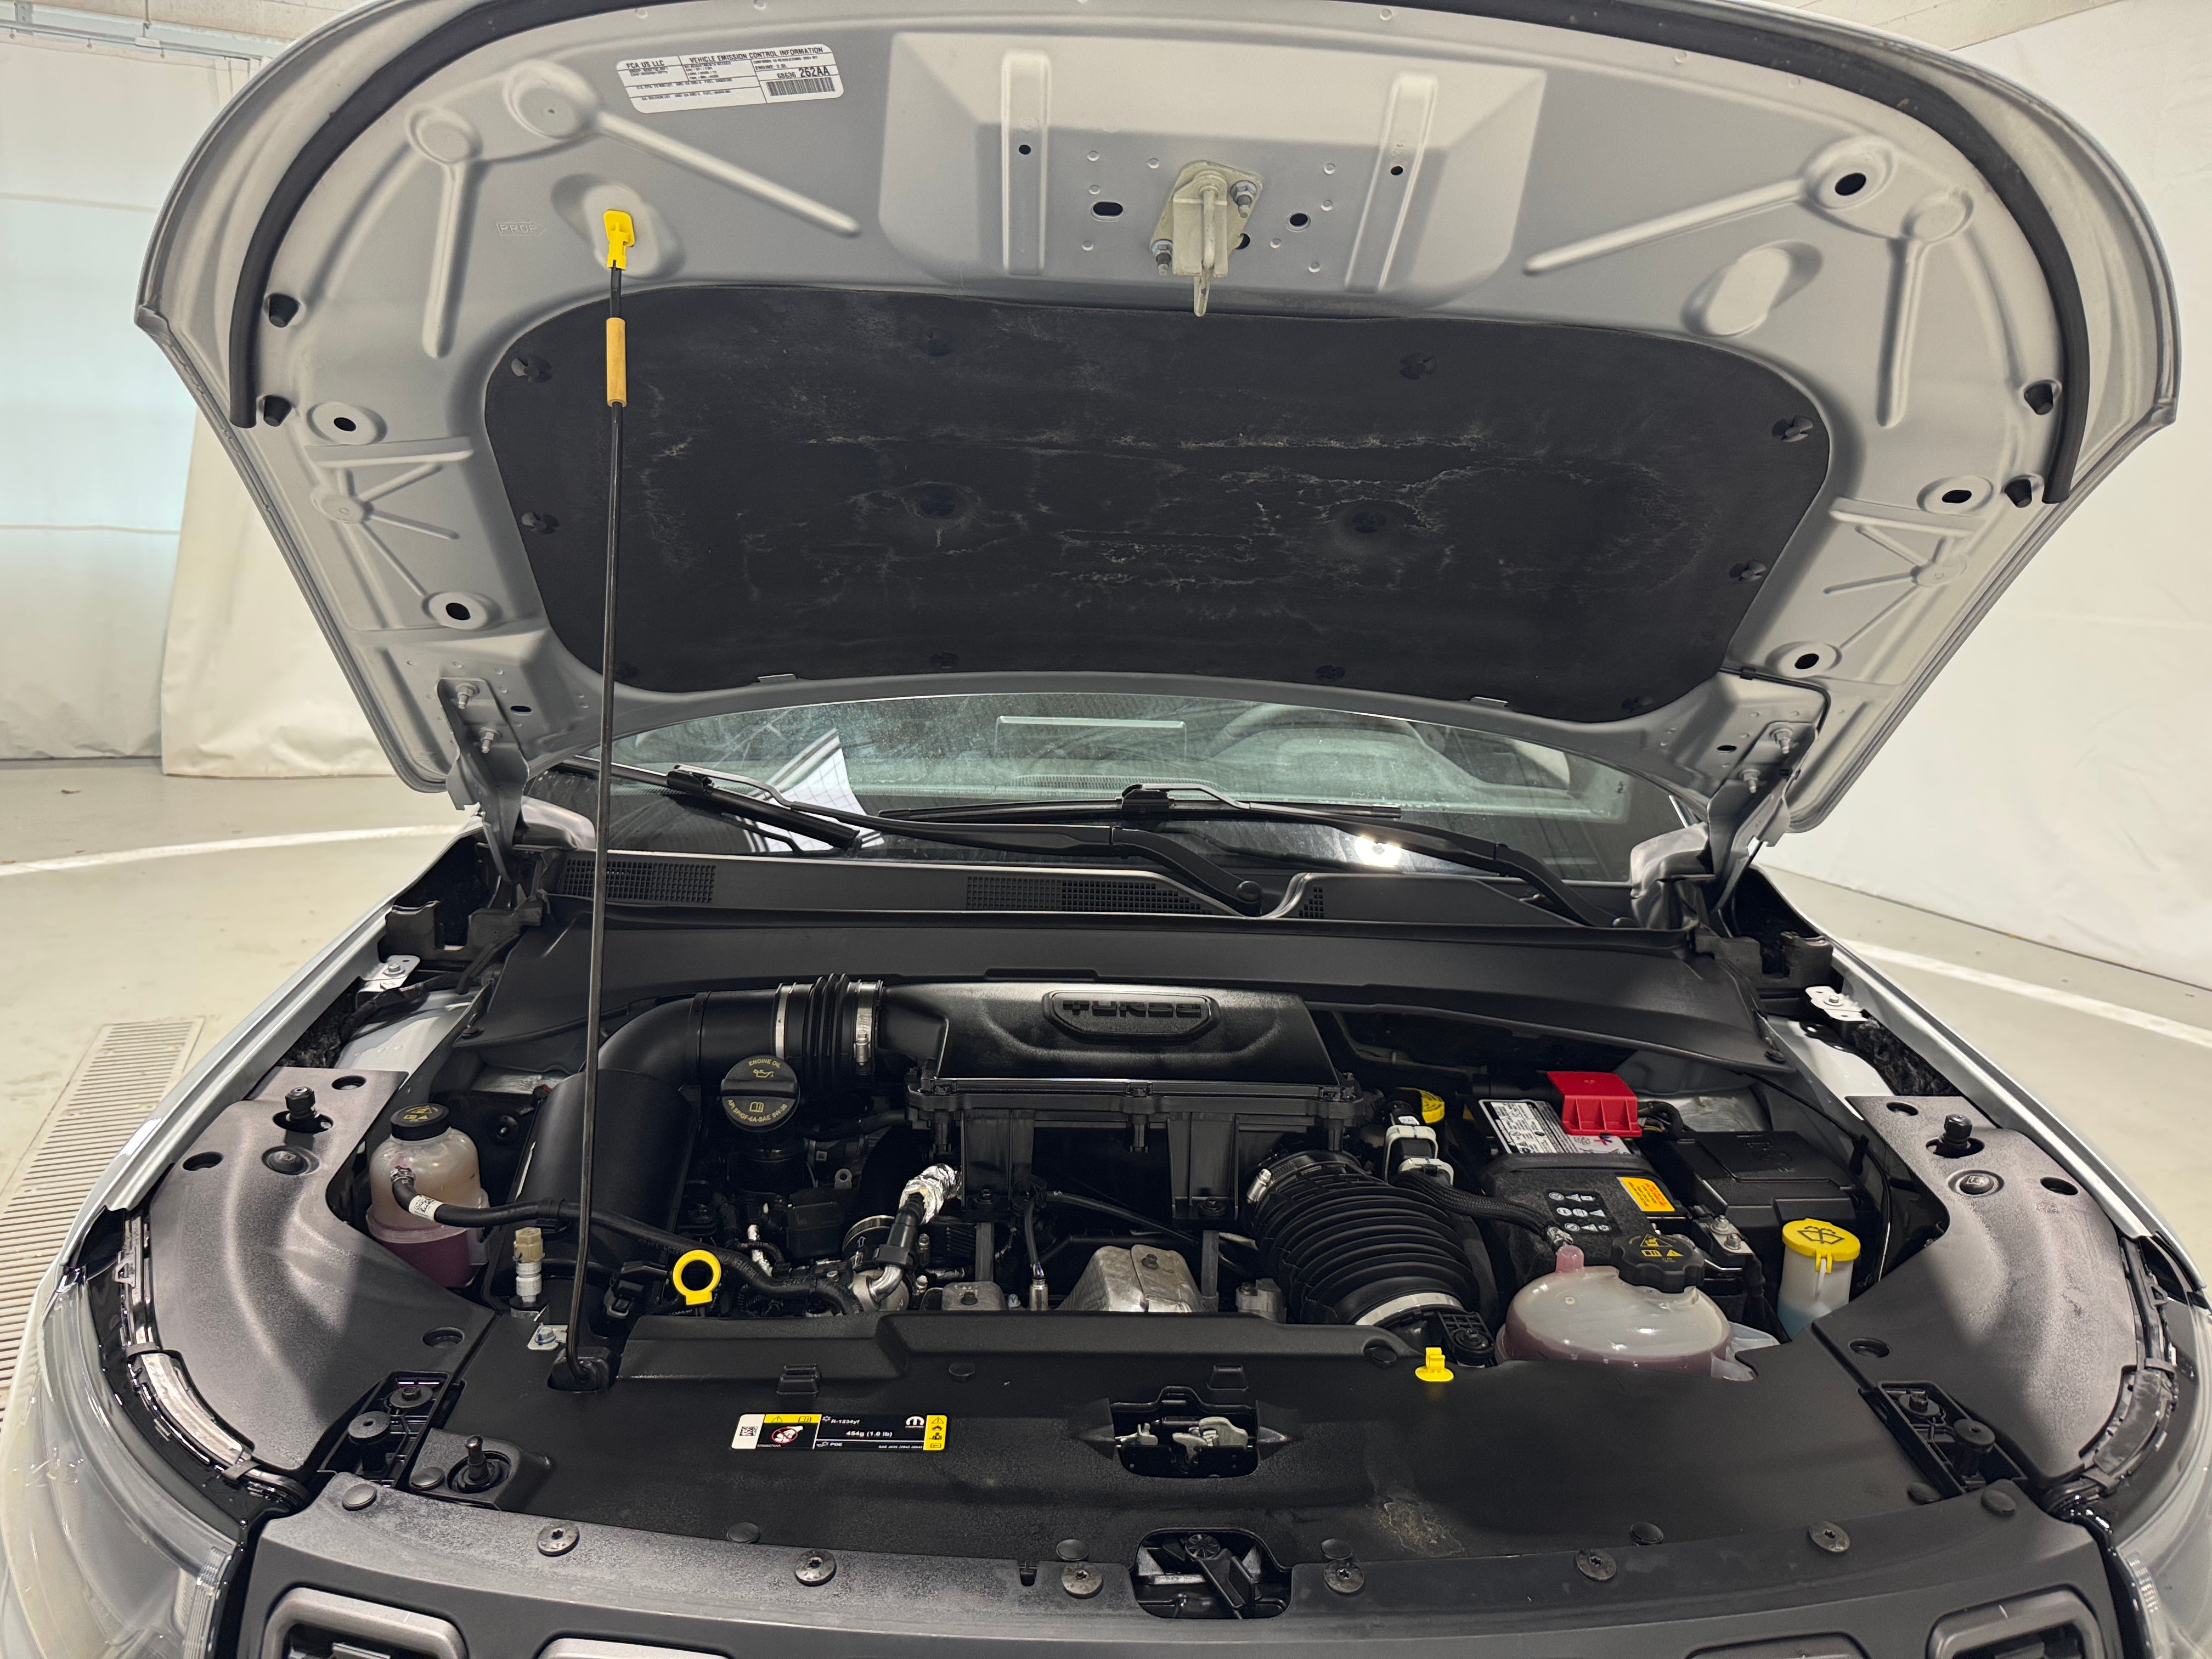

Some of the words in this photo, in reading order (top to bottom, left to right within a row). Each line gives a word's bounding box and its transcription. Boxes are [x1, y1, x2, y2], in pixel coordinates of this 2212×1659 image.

[717, 53, 747, 61] EMISSION
[779, 47, 823, 56] INFORMATION
[799, 66, 830, 77] 262AA
[499, 224, 537, 233] PROP
[727, 1099, 736, 1109] API
[772, 1103, 787, 1118] 5W-30
